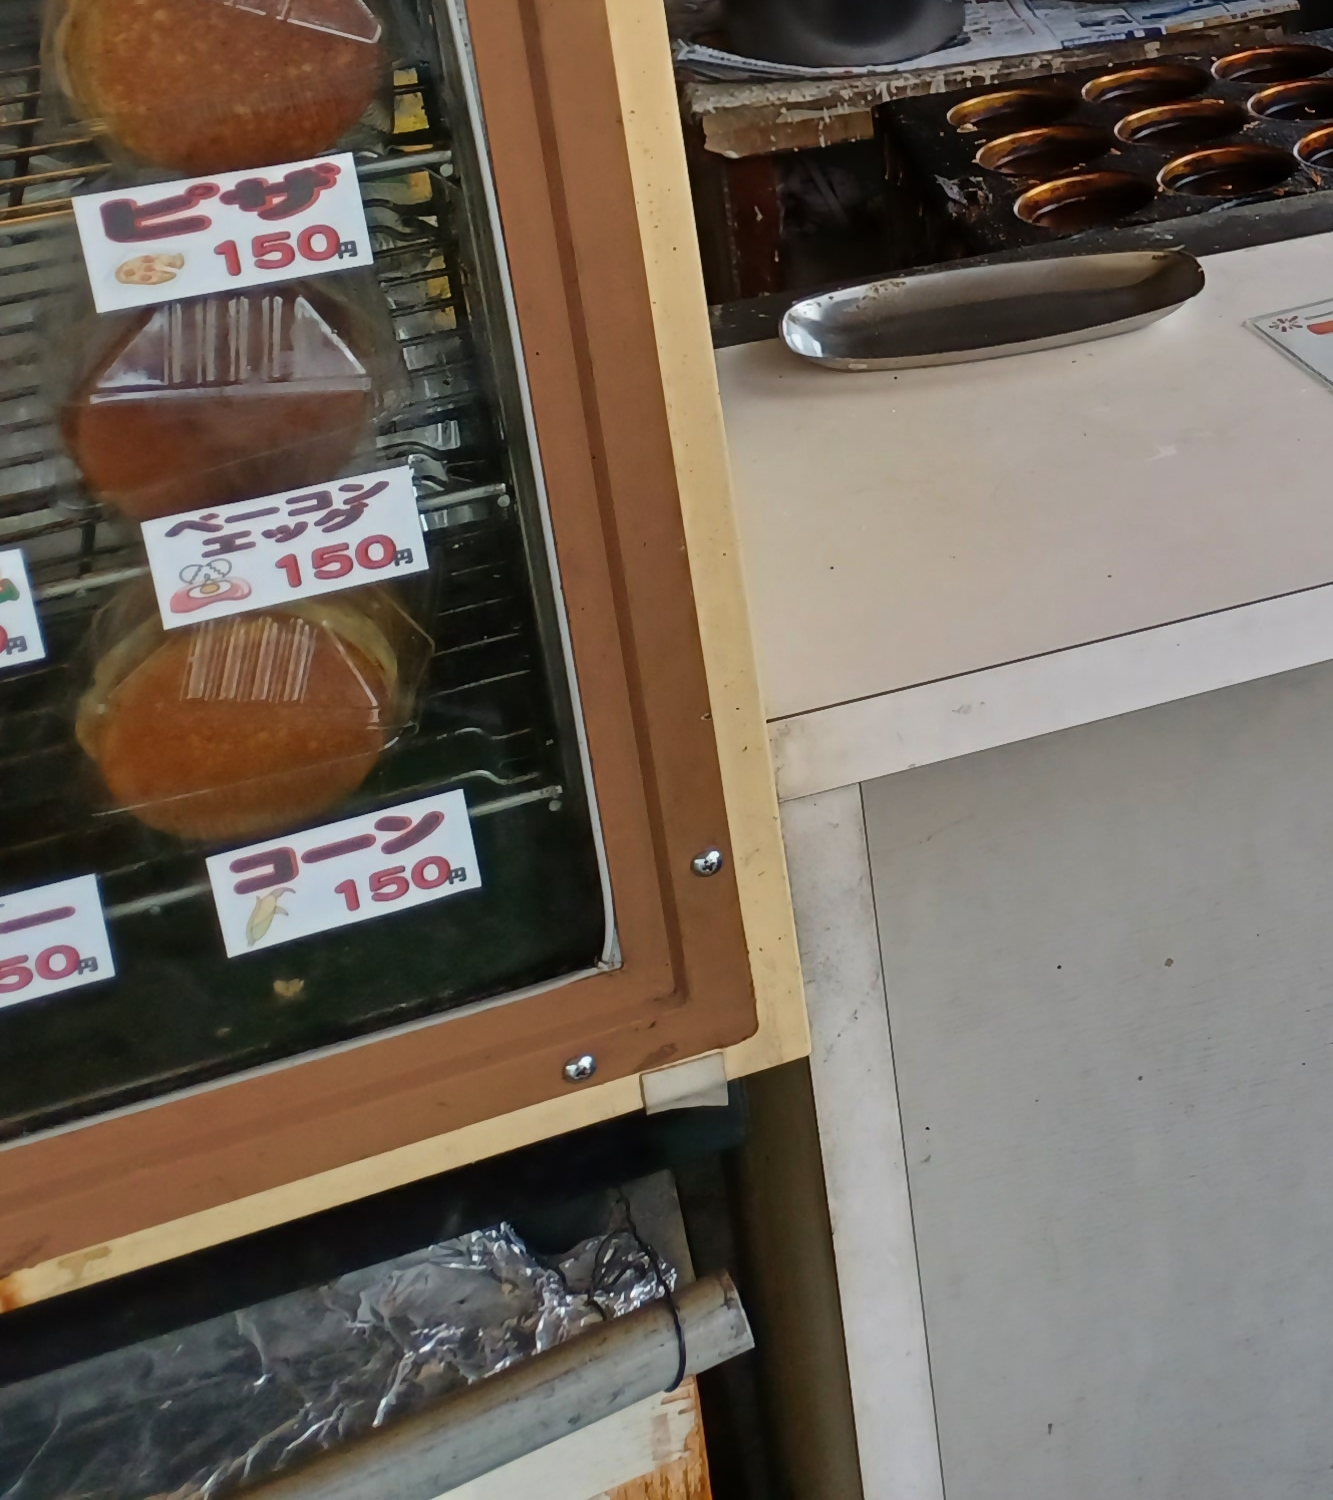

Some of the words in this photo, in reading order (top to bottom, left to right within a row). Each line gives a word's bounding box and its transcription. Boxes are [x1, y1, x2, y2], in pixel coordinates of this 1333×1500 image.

[100, 162, 341, 243] ピザ
[164, 480, 390, 537] ベーコン
[201, 501, 369, 558] エッグ
[229, 810, 445, 895] コーン
